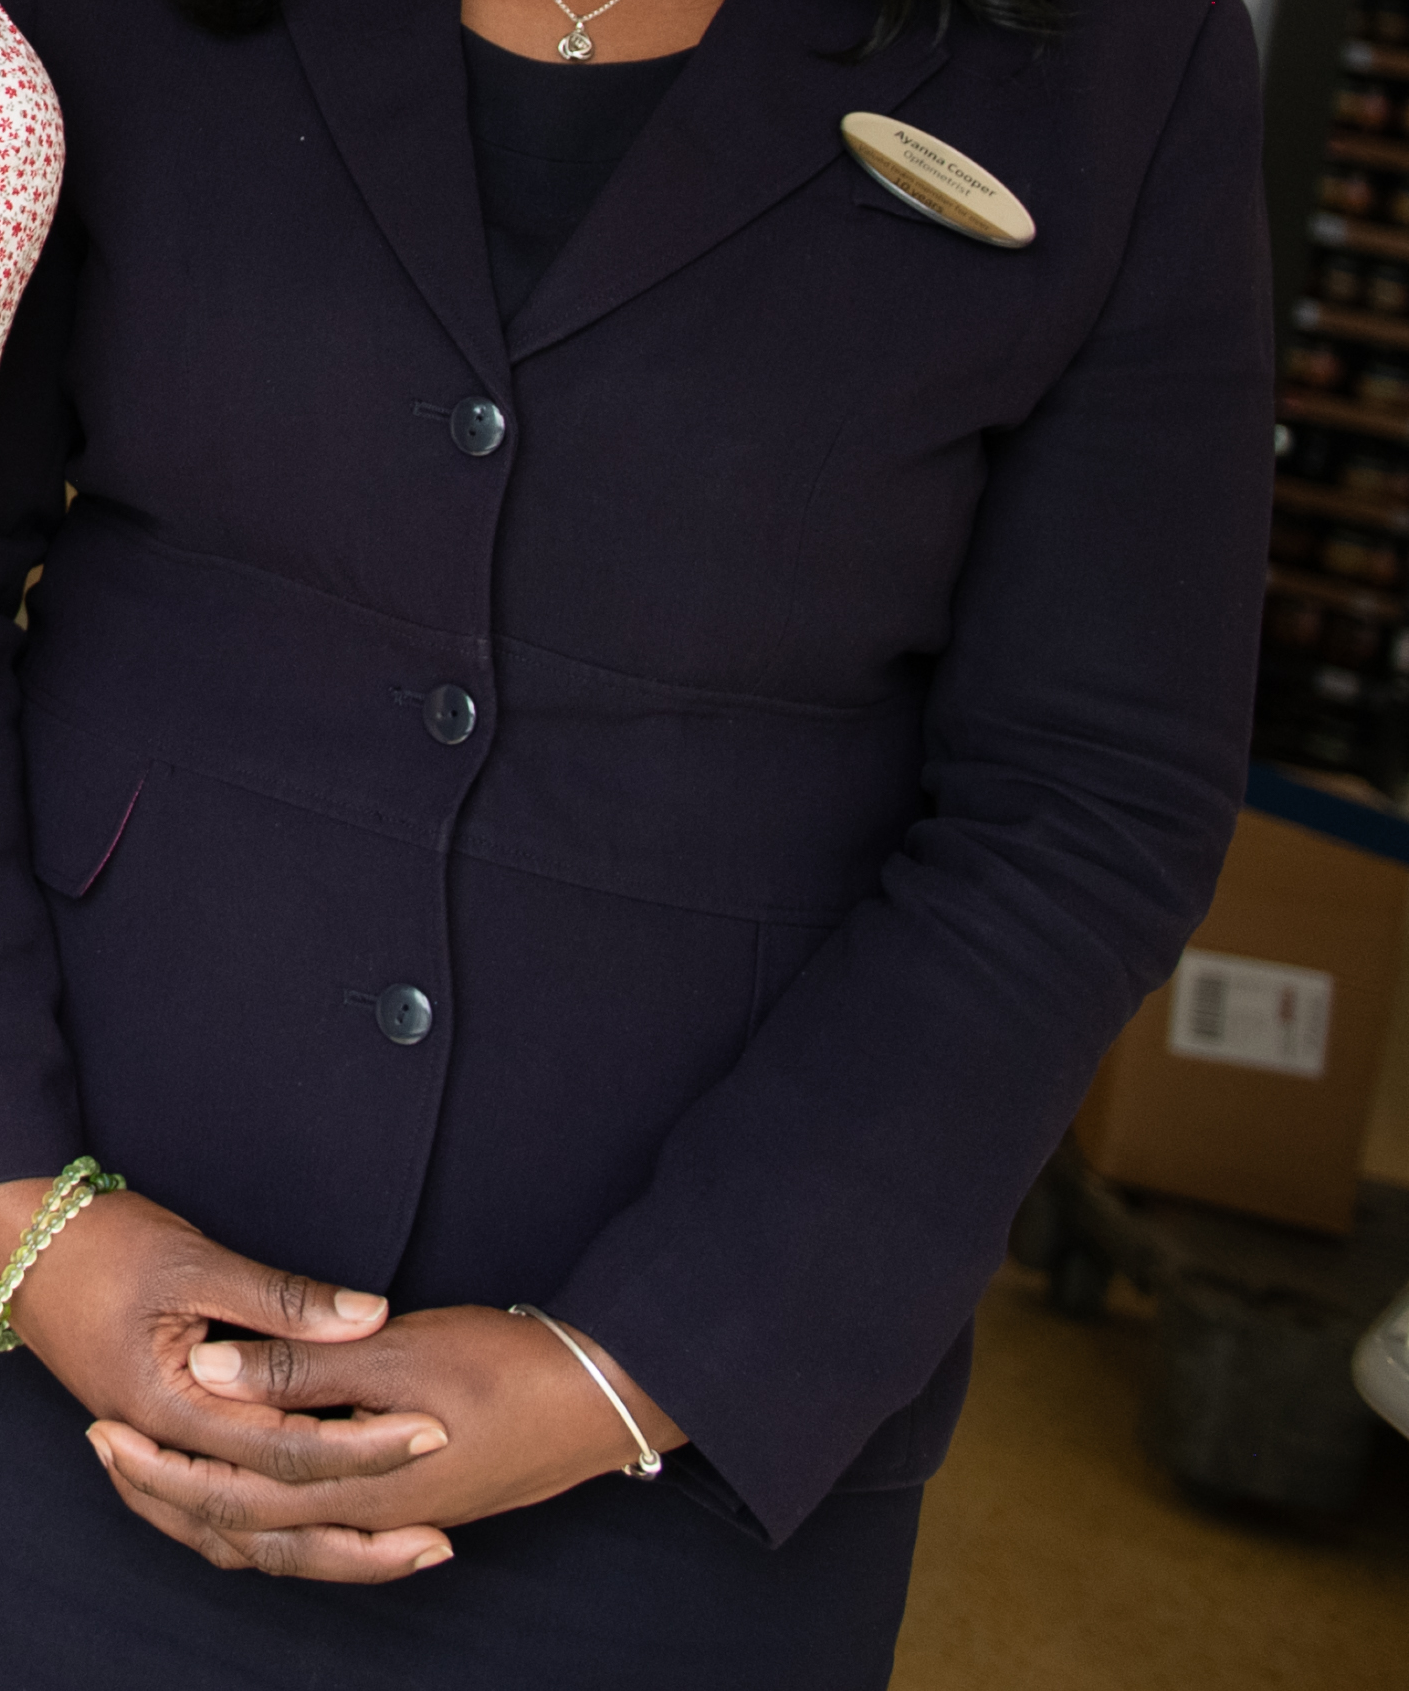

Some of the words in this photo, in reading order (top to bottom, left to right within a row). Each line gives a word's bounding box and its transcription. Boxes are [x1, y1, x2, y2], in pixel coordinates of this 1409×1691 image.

[894, 130, 946, 166] Ayanna
[947, 162, 997, 197] Cooper
[903, 149, 971, 197] Optometrist
[910, 188, 945, 215] years
